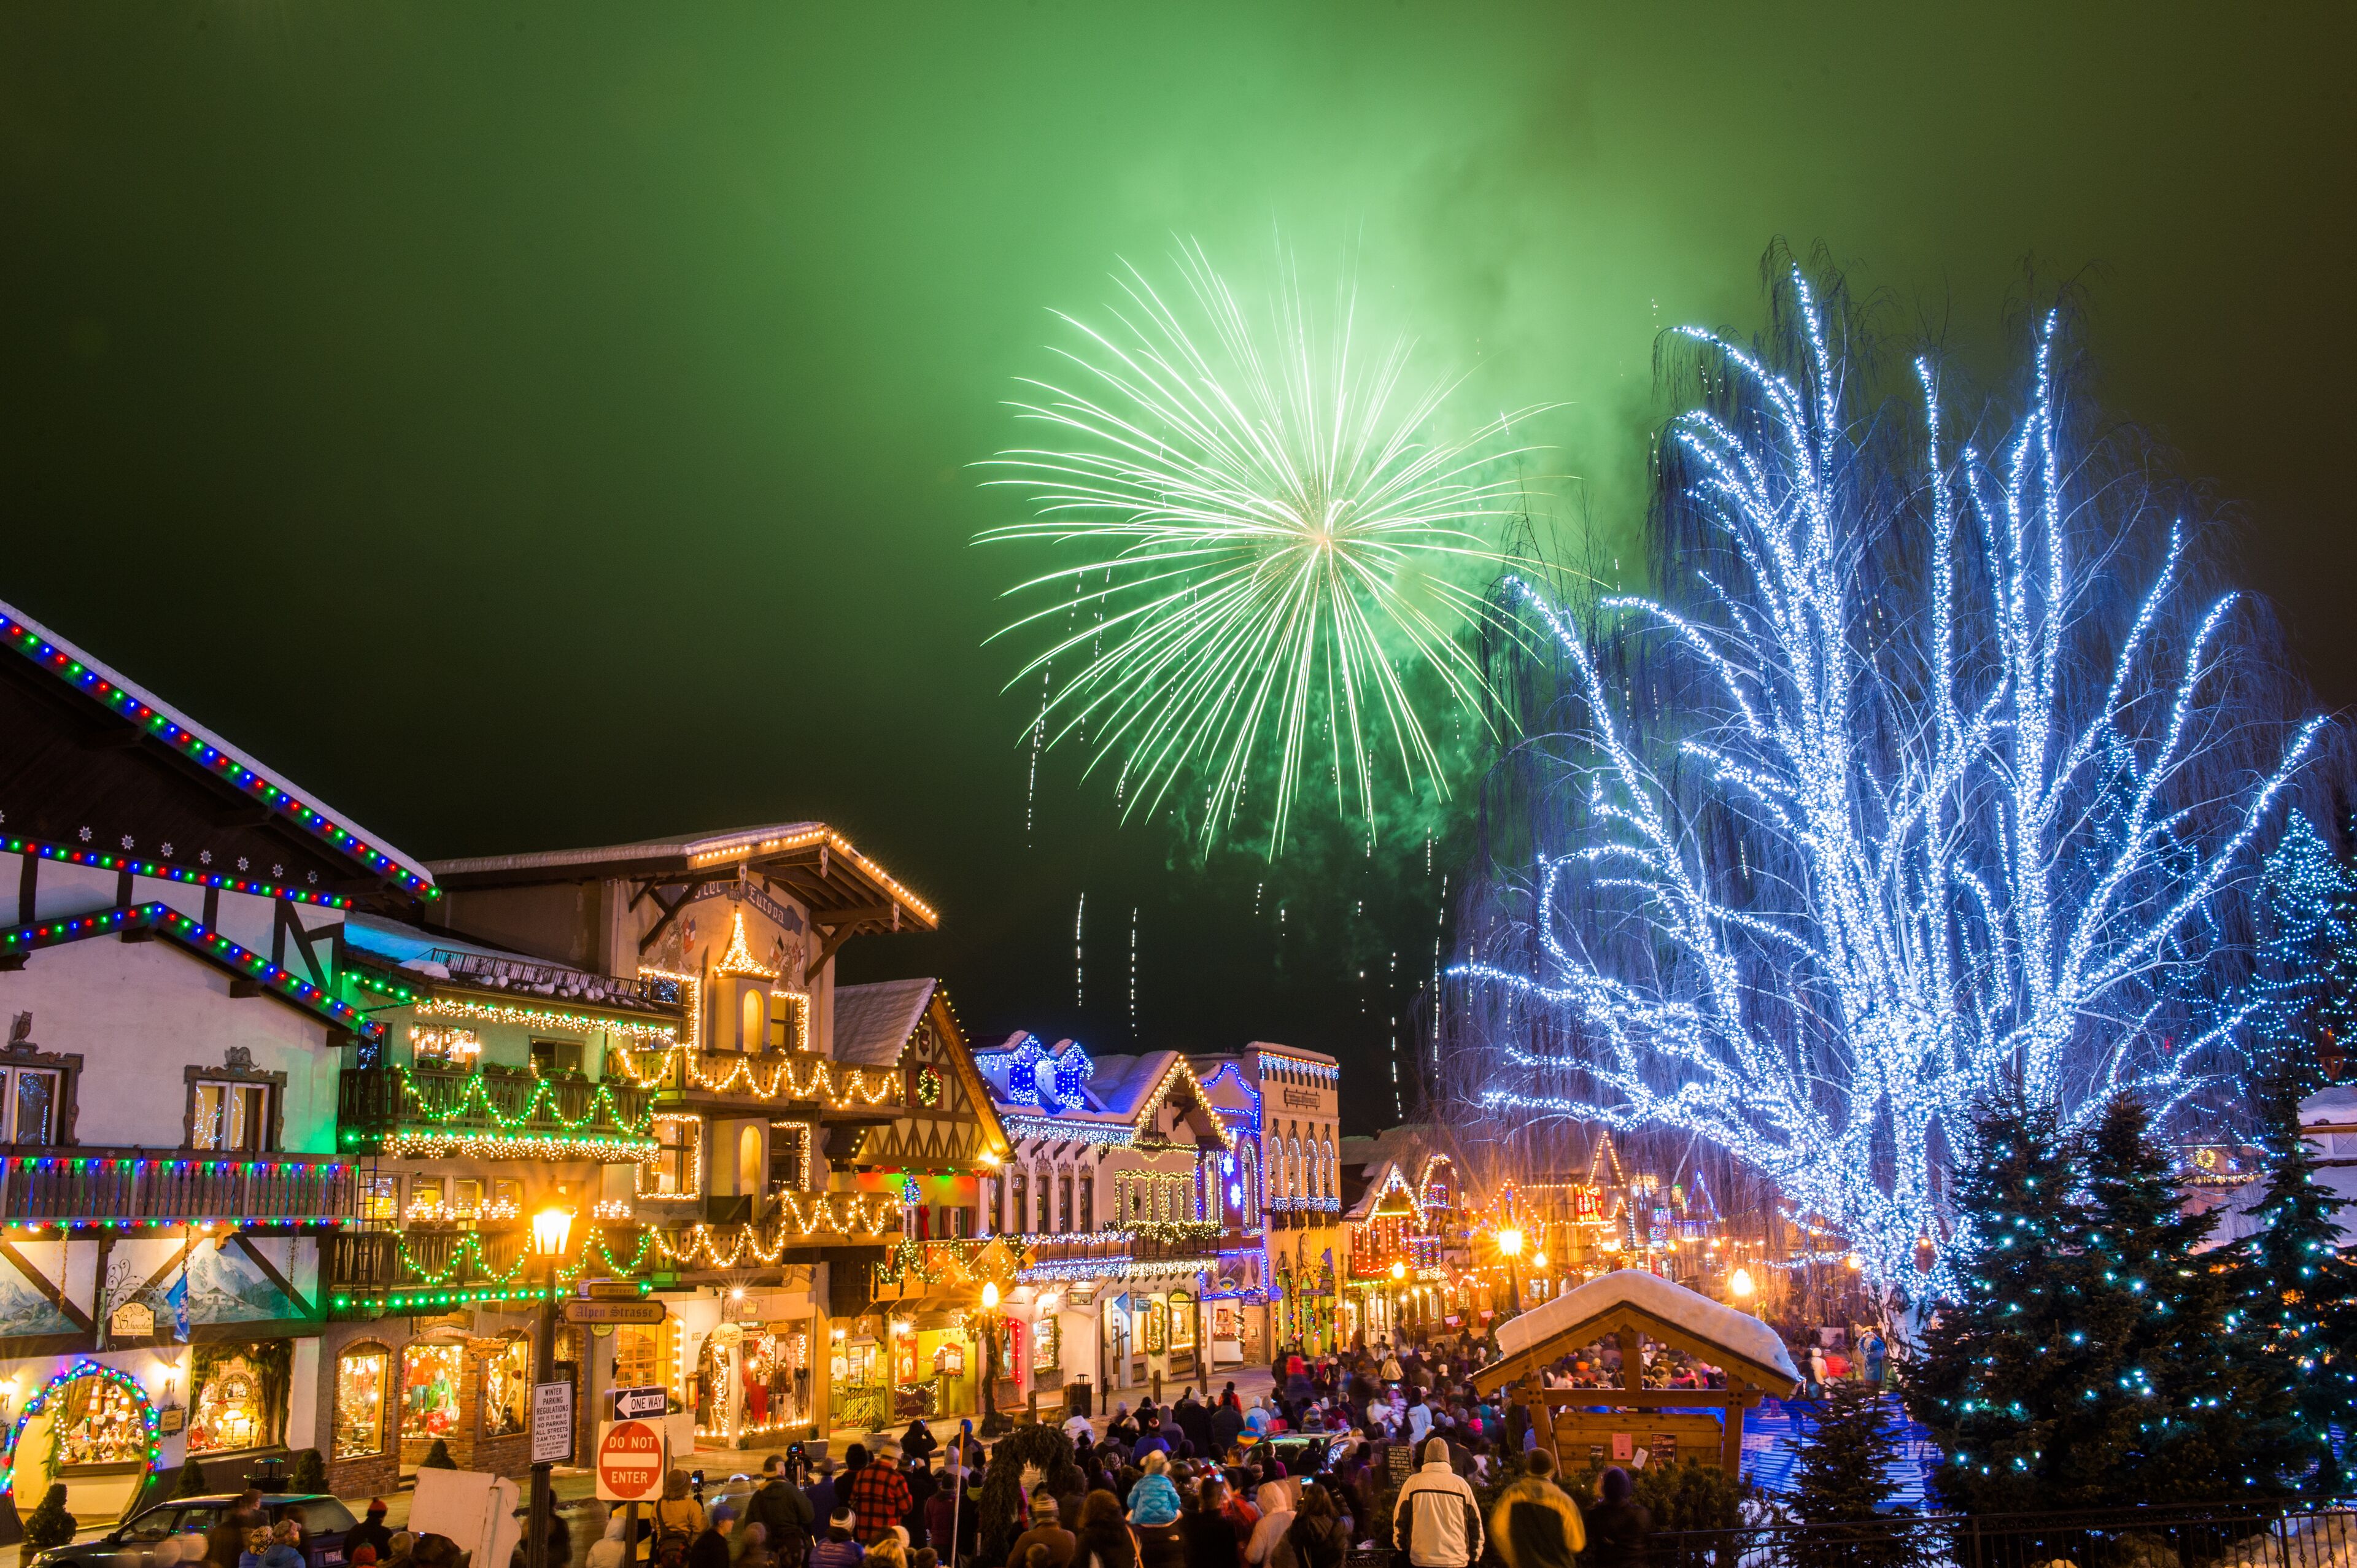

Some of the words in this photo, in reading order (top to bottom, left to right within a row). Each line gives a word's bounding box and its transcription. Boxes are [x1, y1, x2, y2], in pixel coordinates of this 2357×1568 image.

[748, 884, 784, 924] Europa
[575, 1305, 606, 1319] Alpen
[610, 1306, 654, 1318] Strasse
[113, 1314, 152, 1330] Schocolat
[691, 1332, 702, 1342] 833
[545, 1388, 562, 1396] WINTER
[543, 1396, 563, 1405] PARKING
[631, 1397, 645, 1410] ONE
[648, 1396, 663, 1409] WAY
[536, 1404, 569, 1415] REGULATIONS
[609, 1437, 625, 1449] DO
[631, 1436, 654, 1449] NOT
[611, 1471, 648, 1484] ENTER
